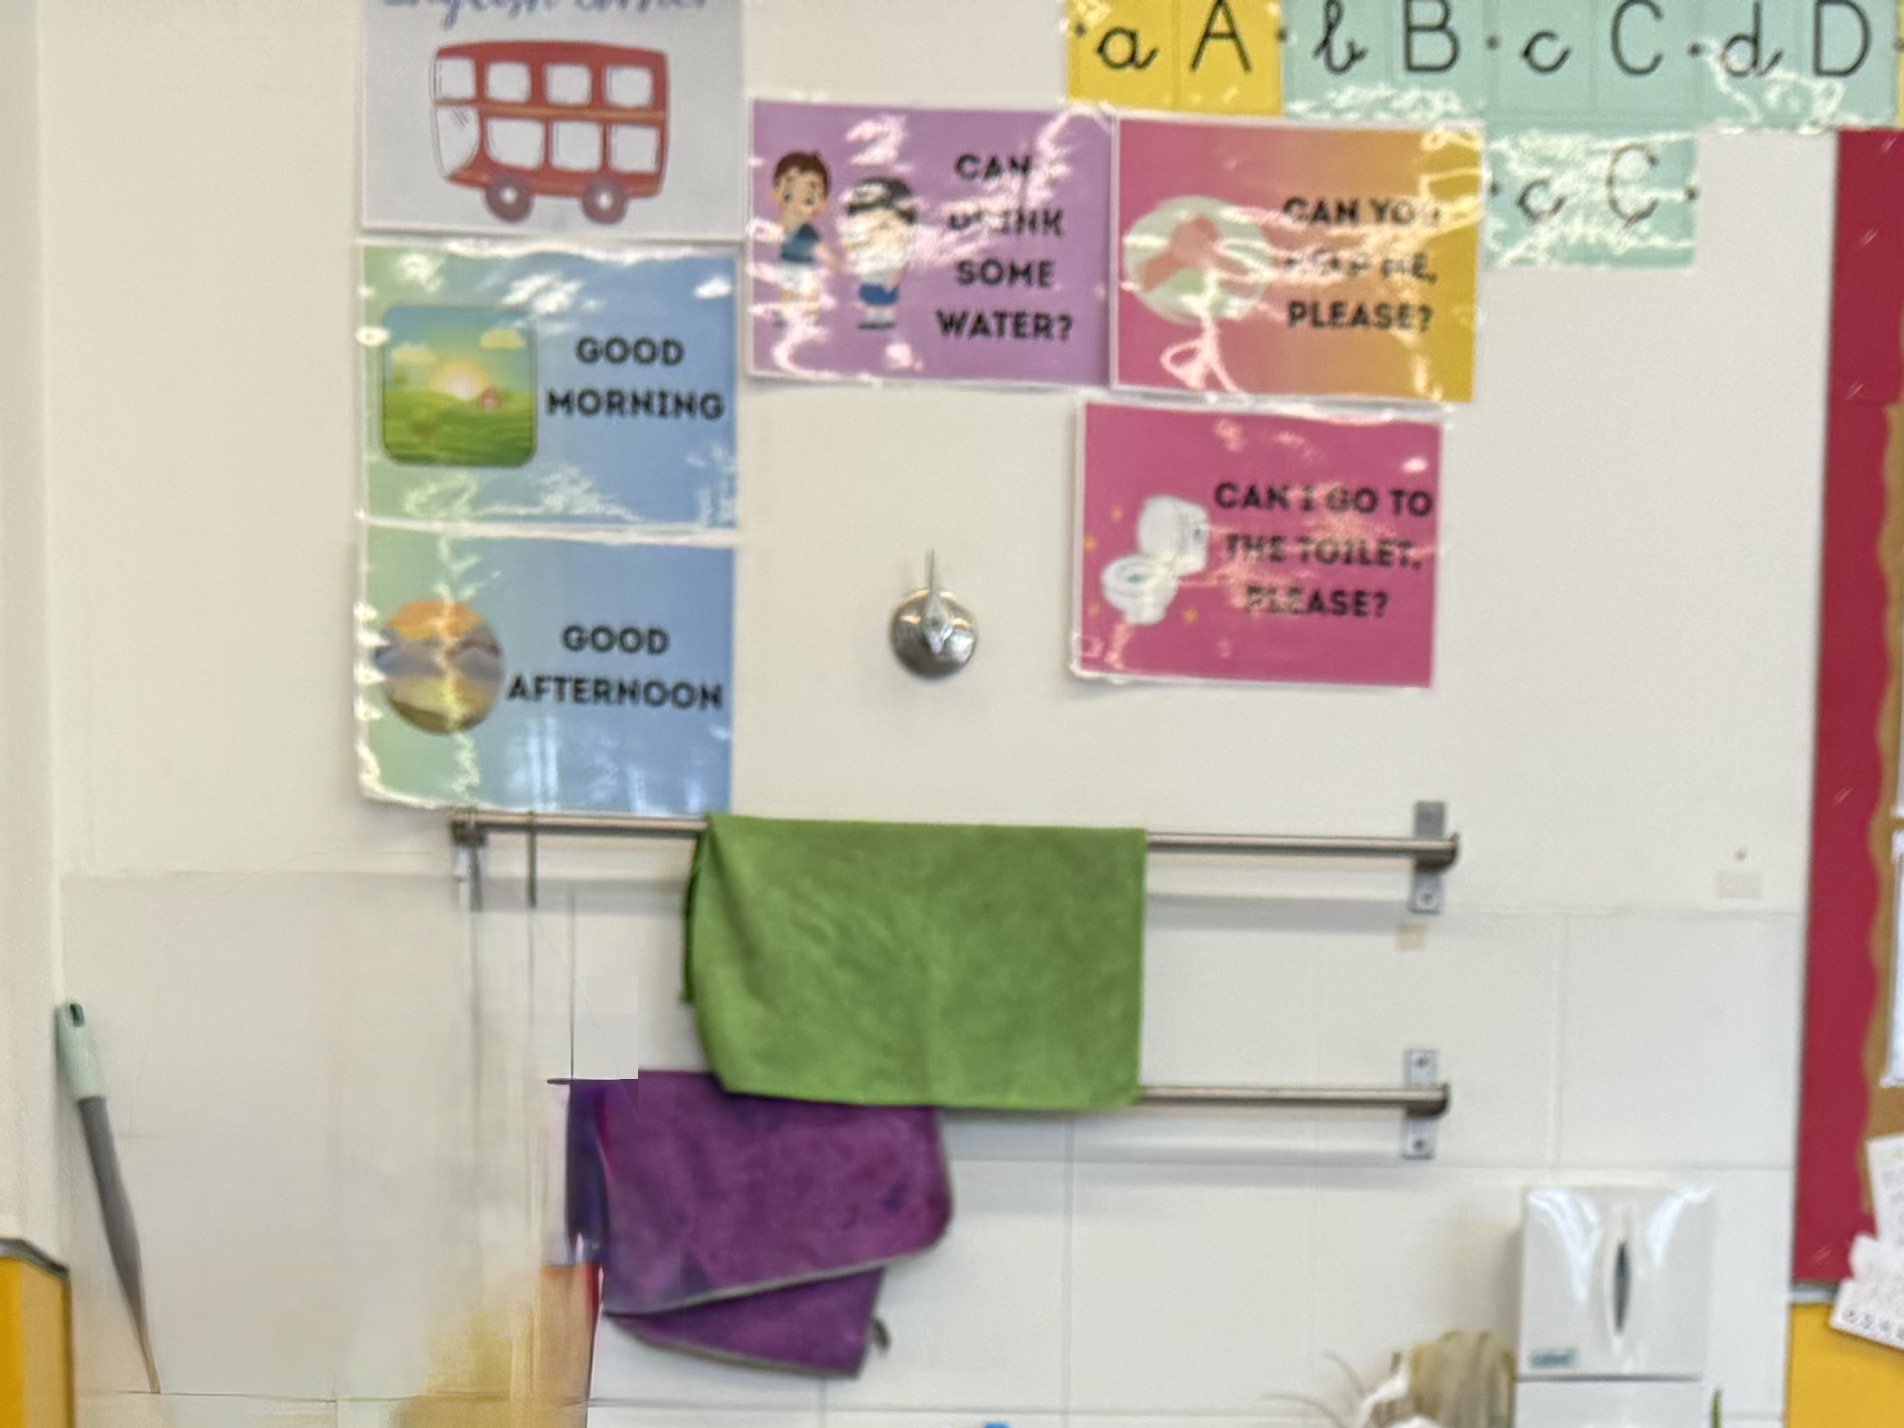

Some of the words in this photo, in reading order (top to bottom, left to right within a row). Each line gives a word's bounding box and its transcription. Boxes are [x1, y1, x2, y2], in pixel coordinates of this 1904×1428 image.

[1095, 27, 1158, 71] a
[1190, 0, 1252, 73] A
[1314, 0, 1368, 76] b
[1403, 0, 1461, 74] B
[1519, 30, 1571, 75] c
[1610, 0, 1663, 77] C
[1724, 0, 1784, 78] d
[1812, 0, 1872, 78] D
[1282, 197, 1359, 226] CAN
[1369, 198, 1442, 226] YO
[956, 259, 1056, 288] SOME
[935, 309, 1075, 341] WATER?
[1285, 300, 1435, 332] PLEASE?
[574, 336, 685, 367] GOOD
[545, 387, 727, 422] MORNING
[1214, 482, 1290, 511] CAN
[1325, 486, 1379, 515] GO
[1389, 489, 1435, 517] TO
[1224, 533, 1287, 563] THE
[1298, 536, 1423, 571] TOILET,
[1246, 584, 1389, 618] PLEASE?
[561, 624, 670, 655] GOOD
[507, 673, 725, 711] AFTERNOON
